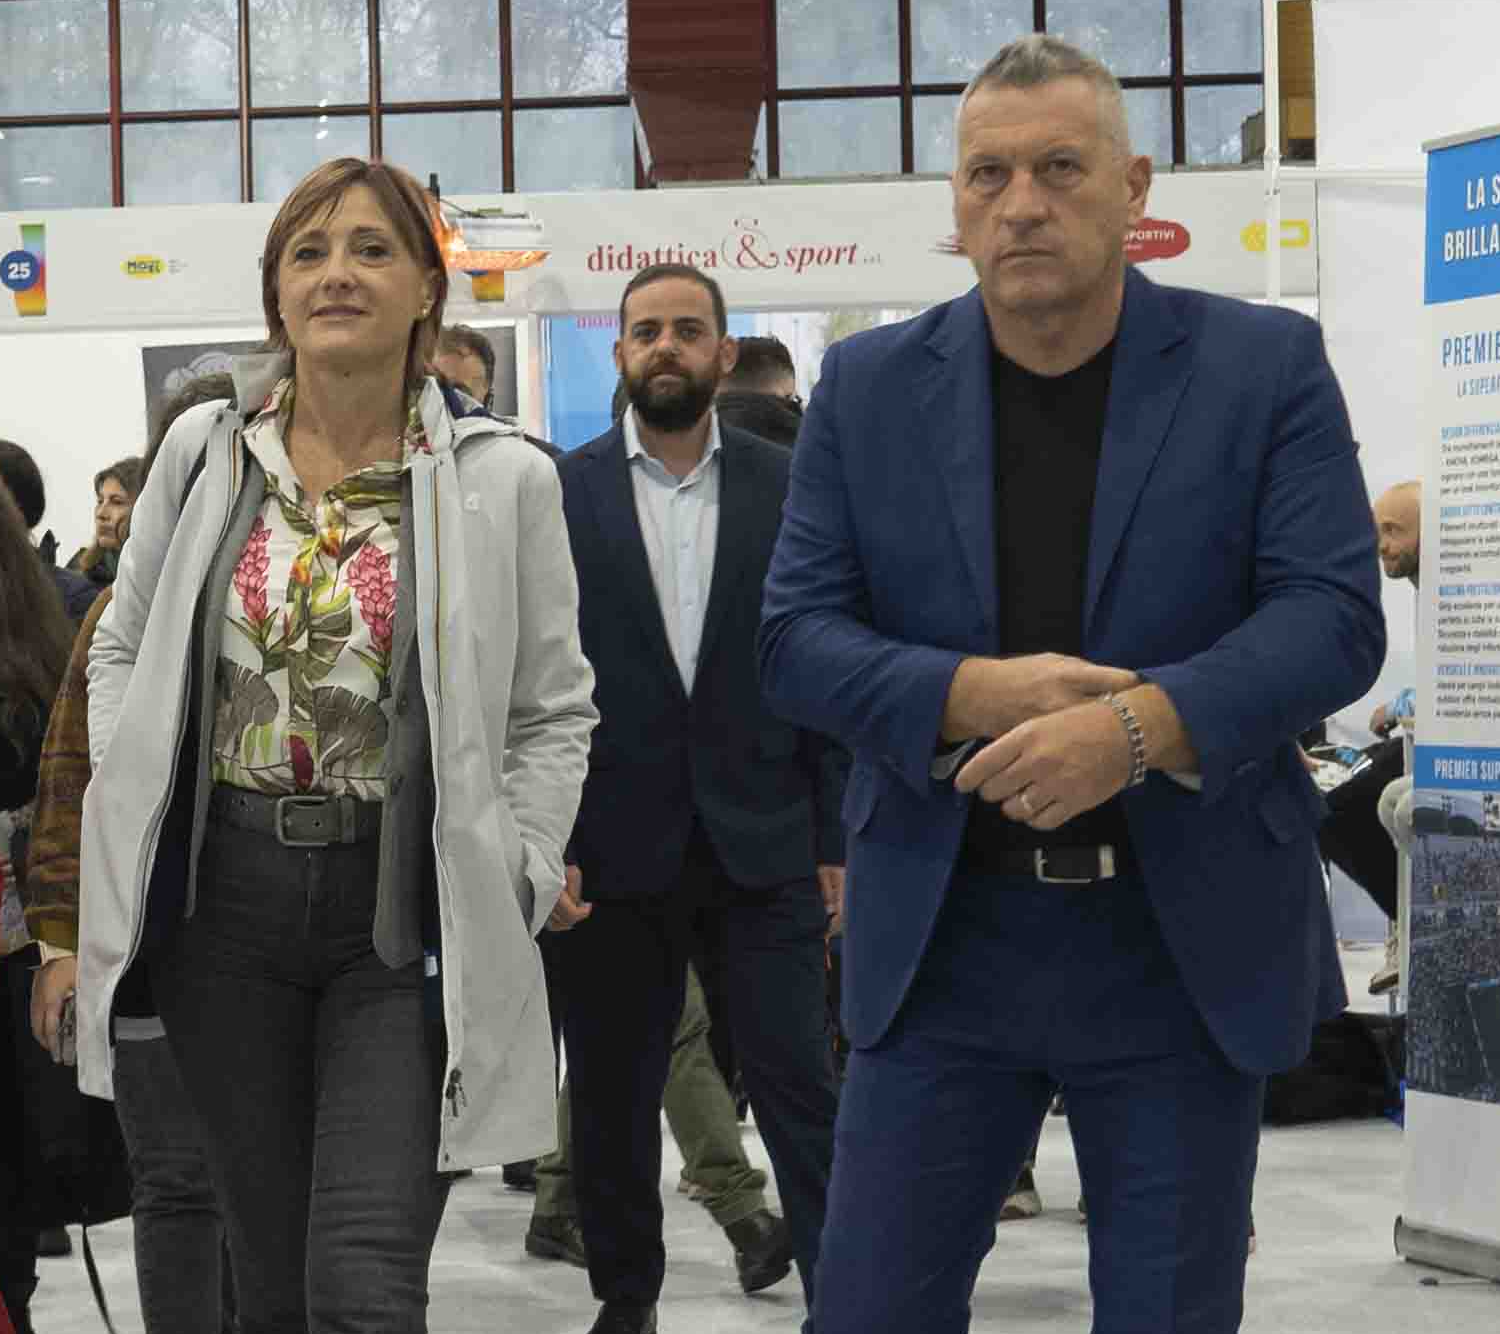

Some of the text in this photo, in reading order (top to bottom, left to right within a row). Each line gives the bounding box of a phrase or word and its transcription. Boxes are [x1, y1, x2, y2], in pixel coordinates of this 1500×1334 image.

[1466, 177, 1486, 211] LA
[7, 262, 31, 279] 25
[586, 244, 719, 272] didattica
[783, 241, 859, 274] sport
[1433, 758, 1479, 780] PREMIER
